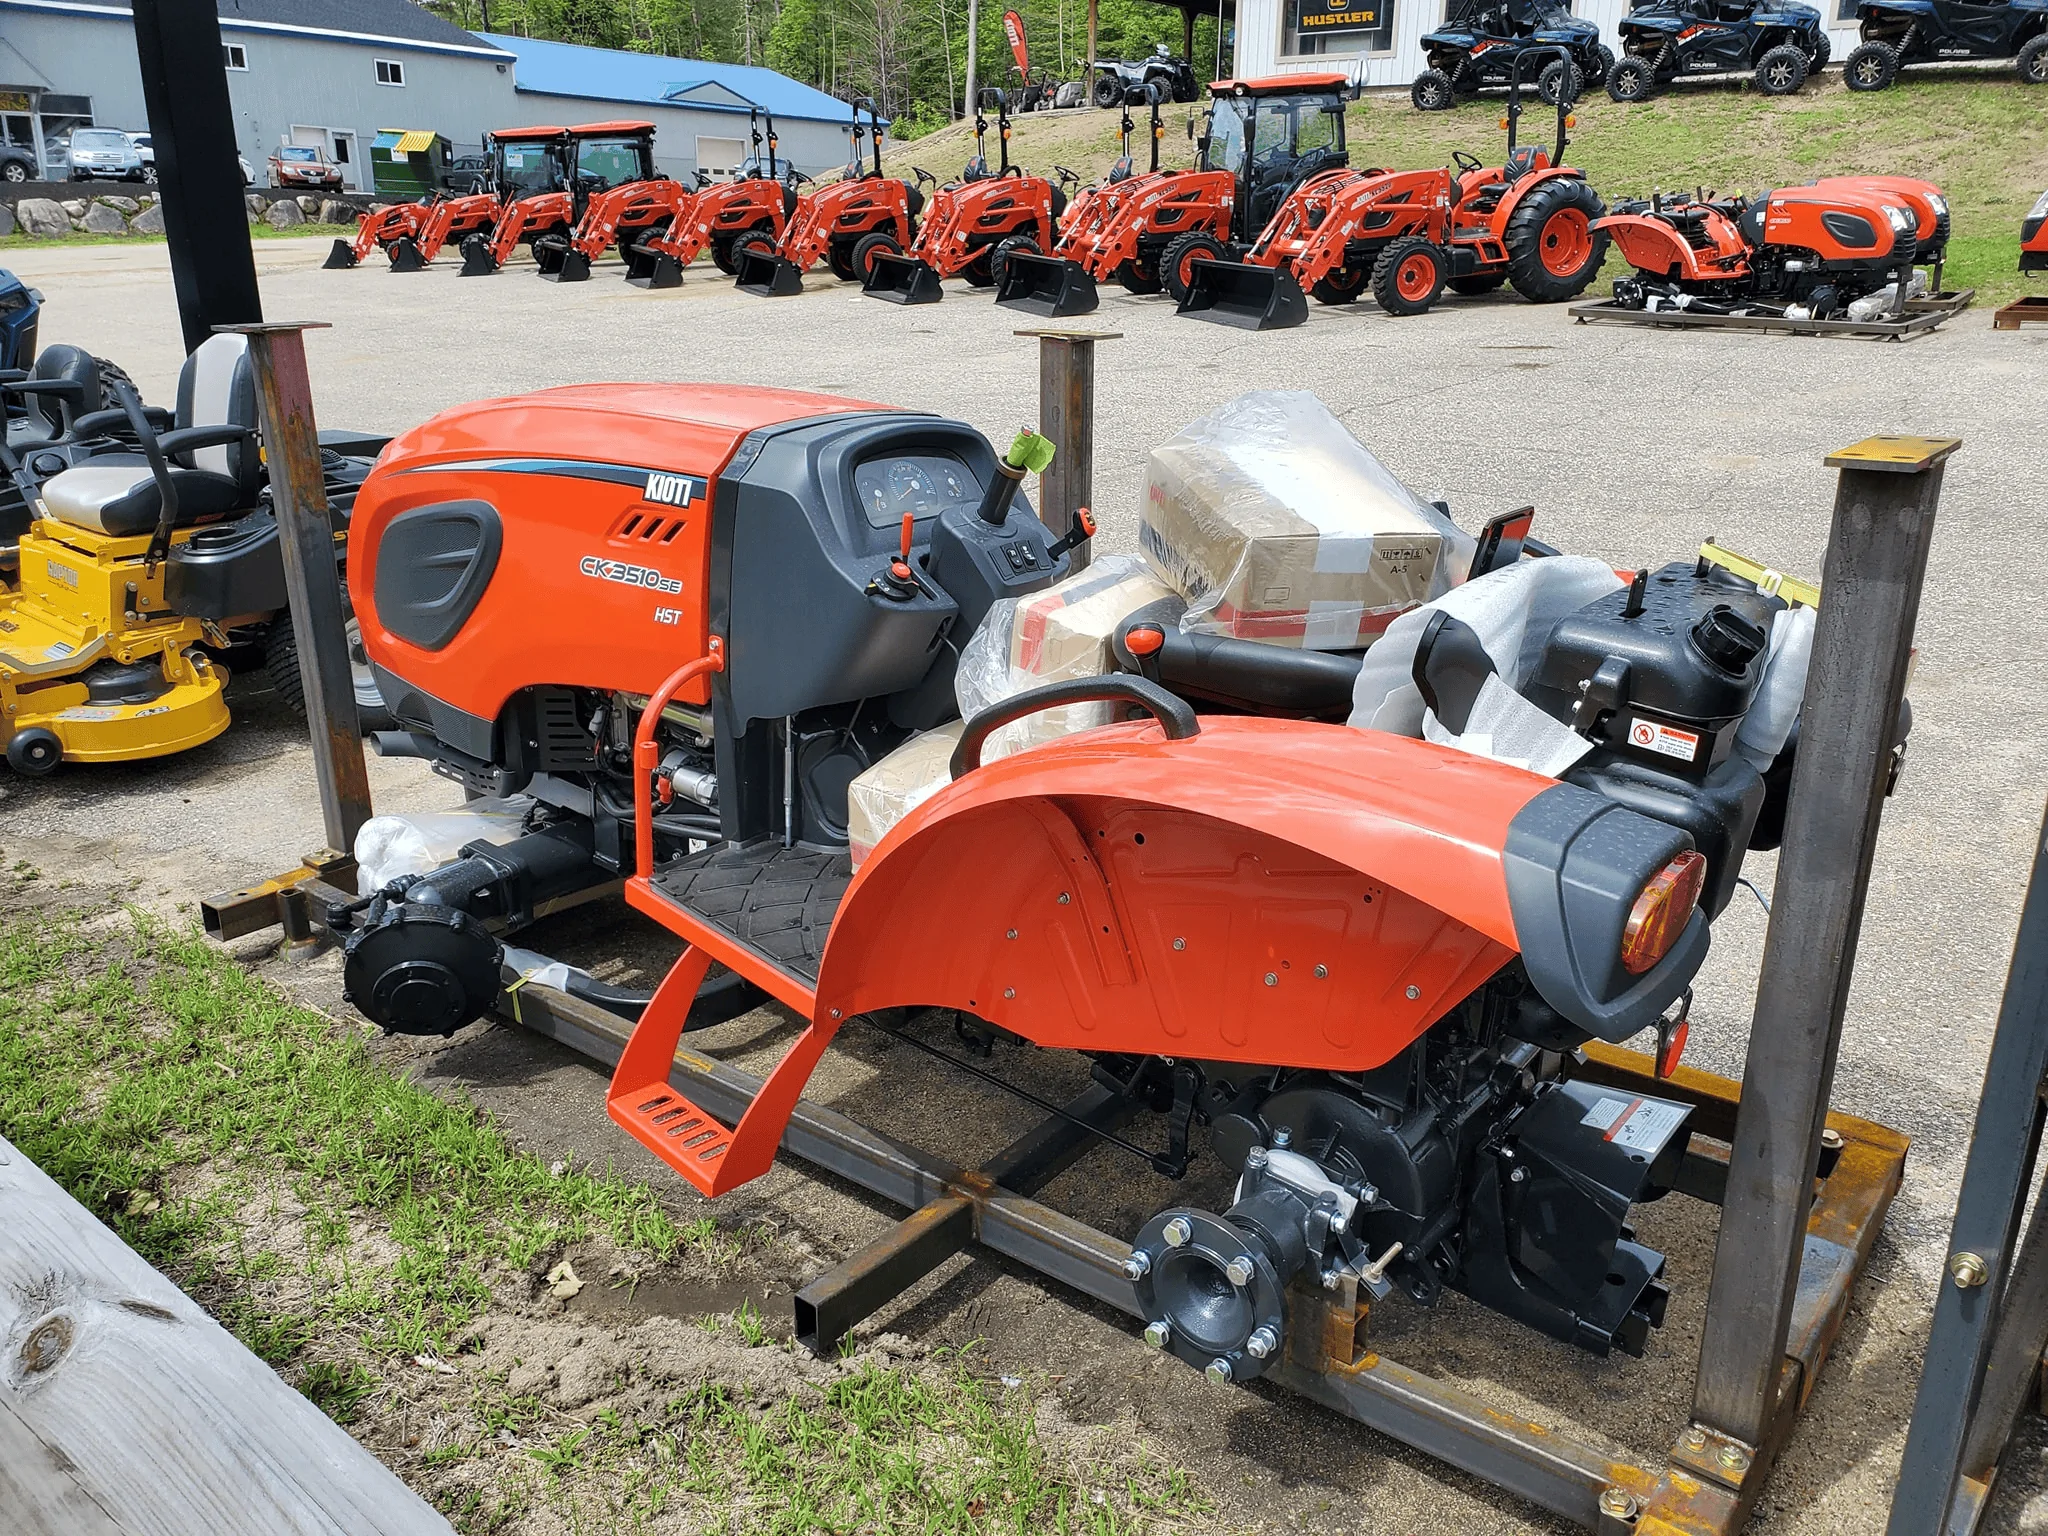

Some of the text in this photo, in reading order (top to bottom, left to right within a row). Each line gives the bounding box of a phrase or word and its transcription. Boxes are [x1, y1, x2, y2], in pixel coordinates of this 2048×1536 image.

[1302, 11, 1375, 27] HUSTLER
[645, 473, 692, 507] KIOTI
[580, 556, 683, 595] CK3510SE
[1390, 564, 1408, 574] A-5
[654, 606, 683, 625] HST
